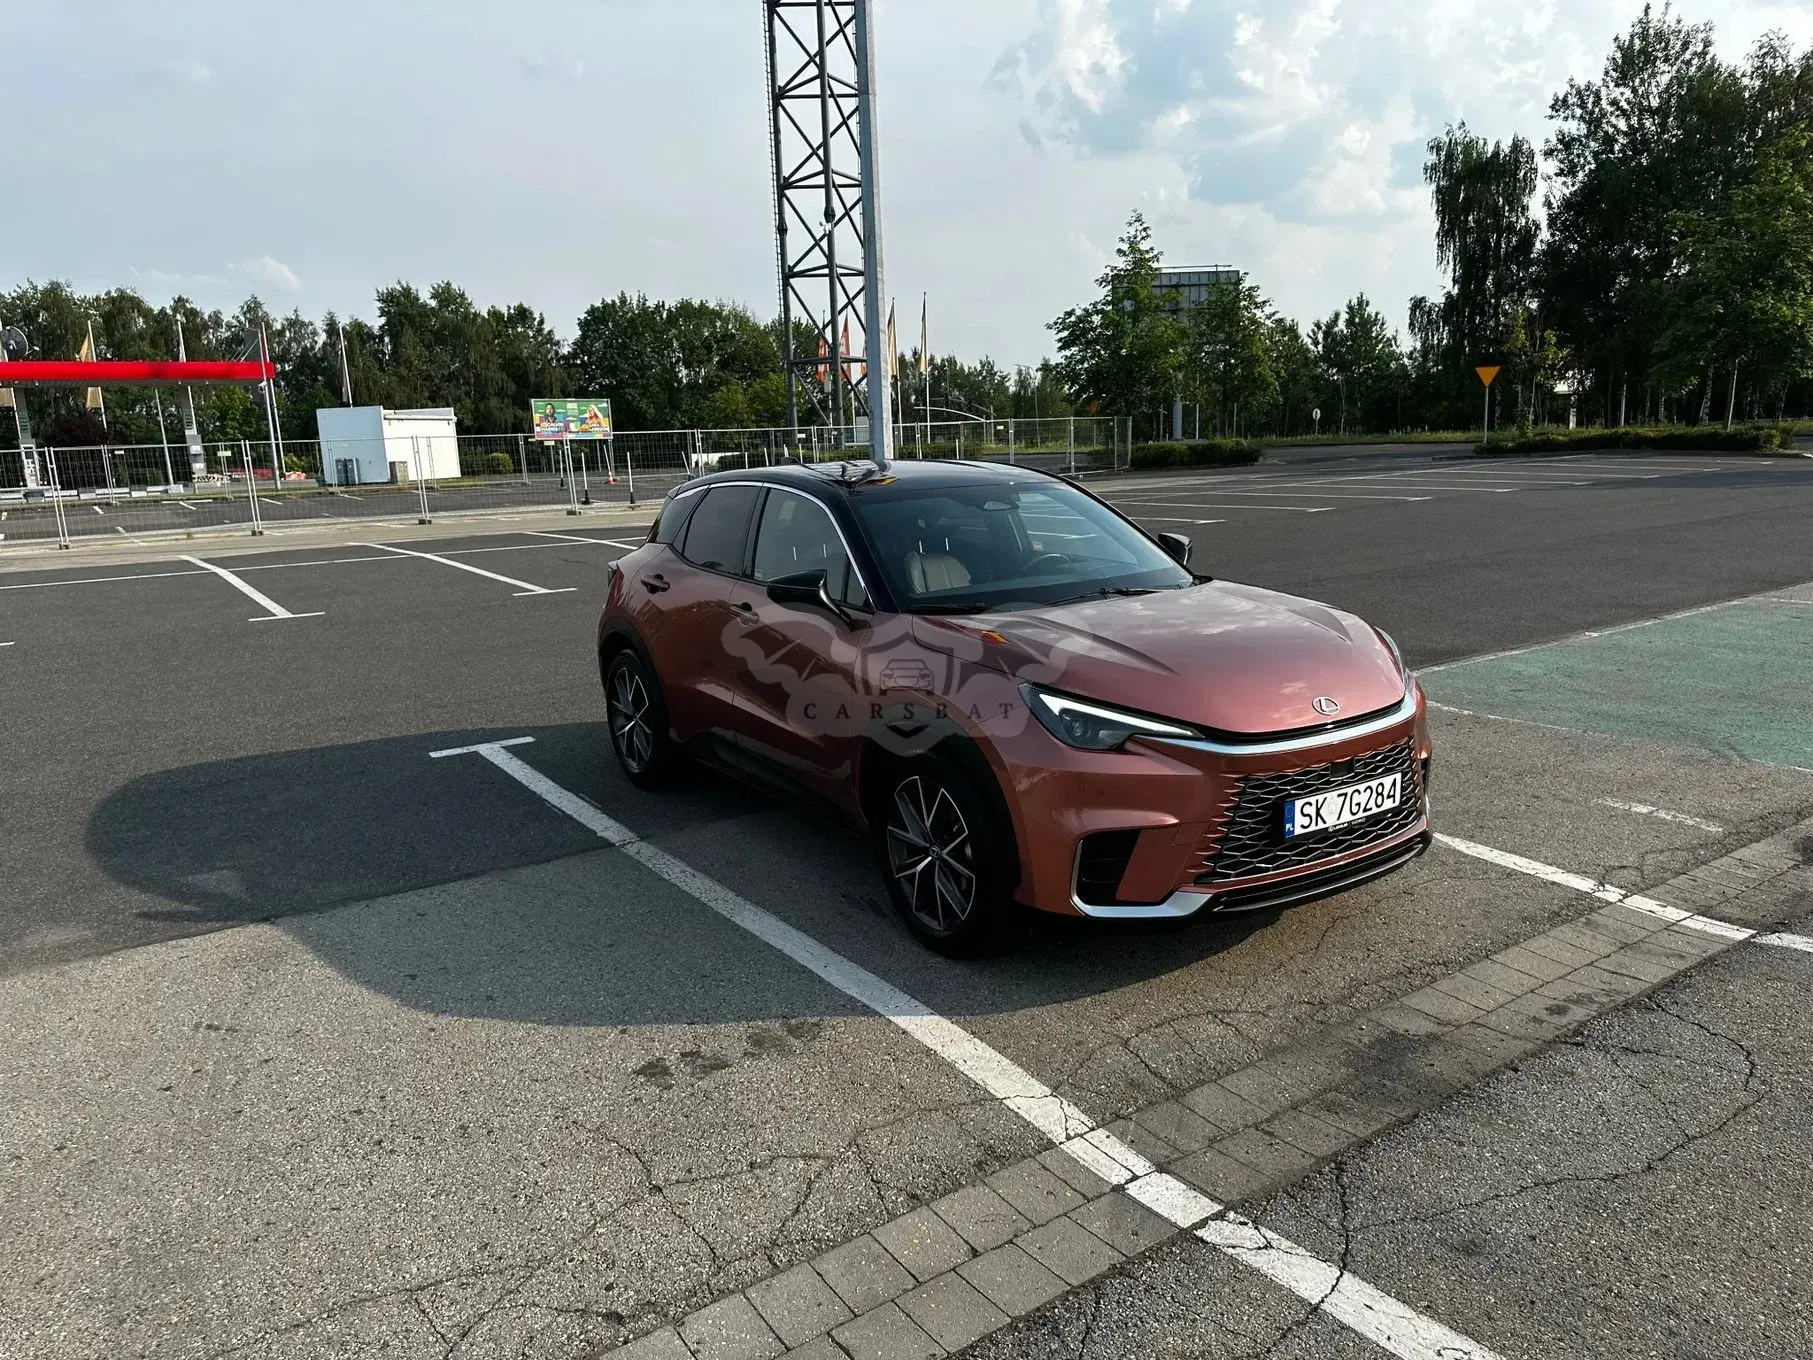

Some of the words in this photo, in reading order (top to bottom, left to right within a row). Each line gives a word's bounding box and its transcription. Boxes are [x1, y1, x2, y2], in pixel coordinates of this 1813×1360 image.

[1300, 797, 1327, 829] SK
[1337, 777, 1397, 821] 7G284
[1285, 823, 1294, 832] PL
